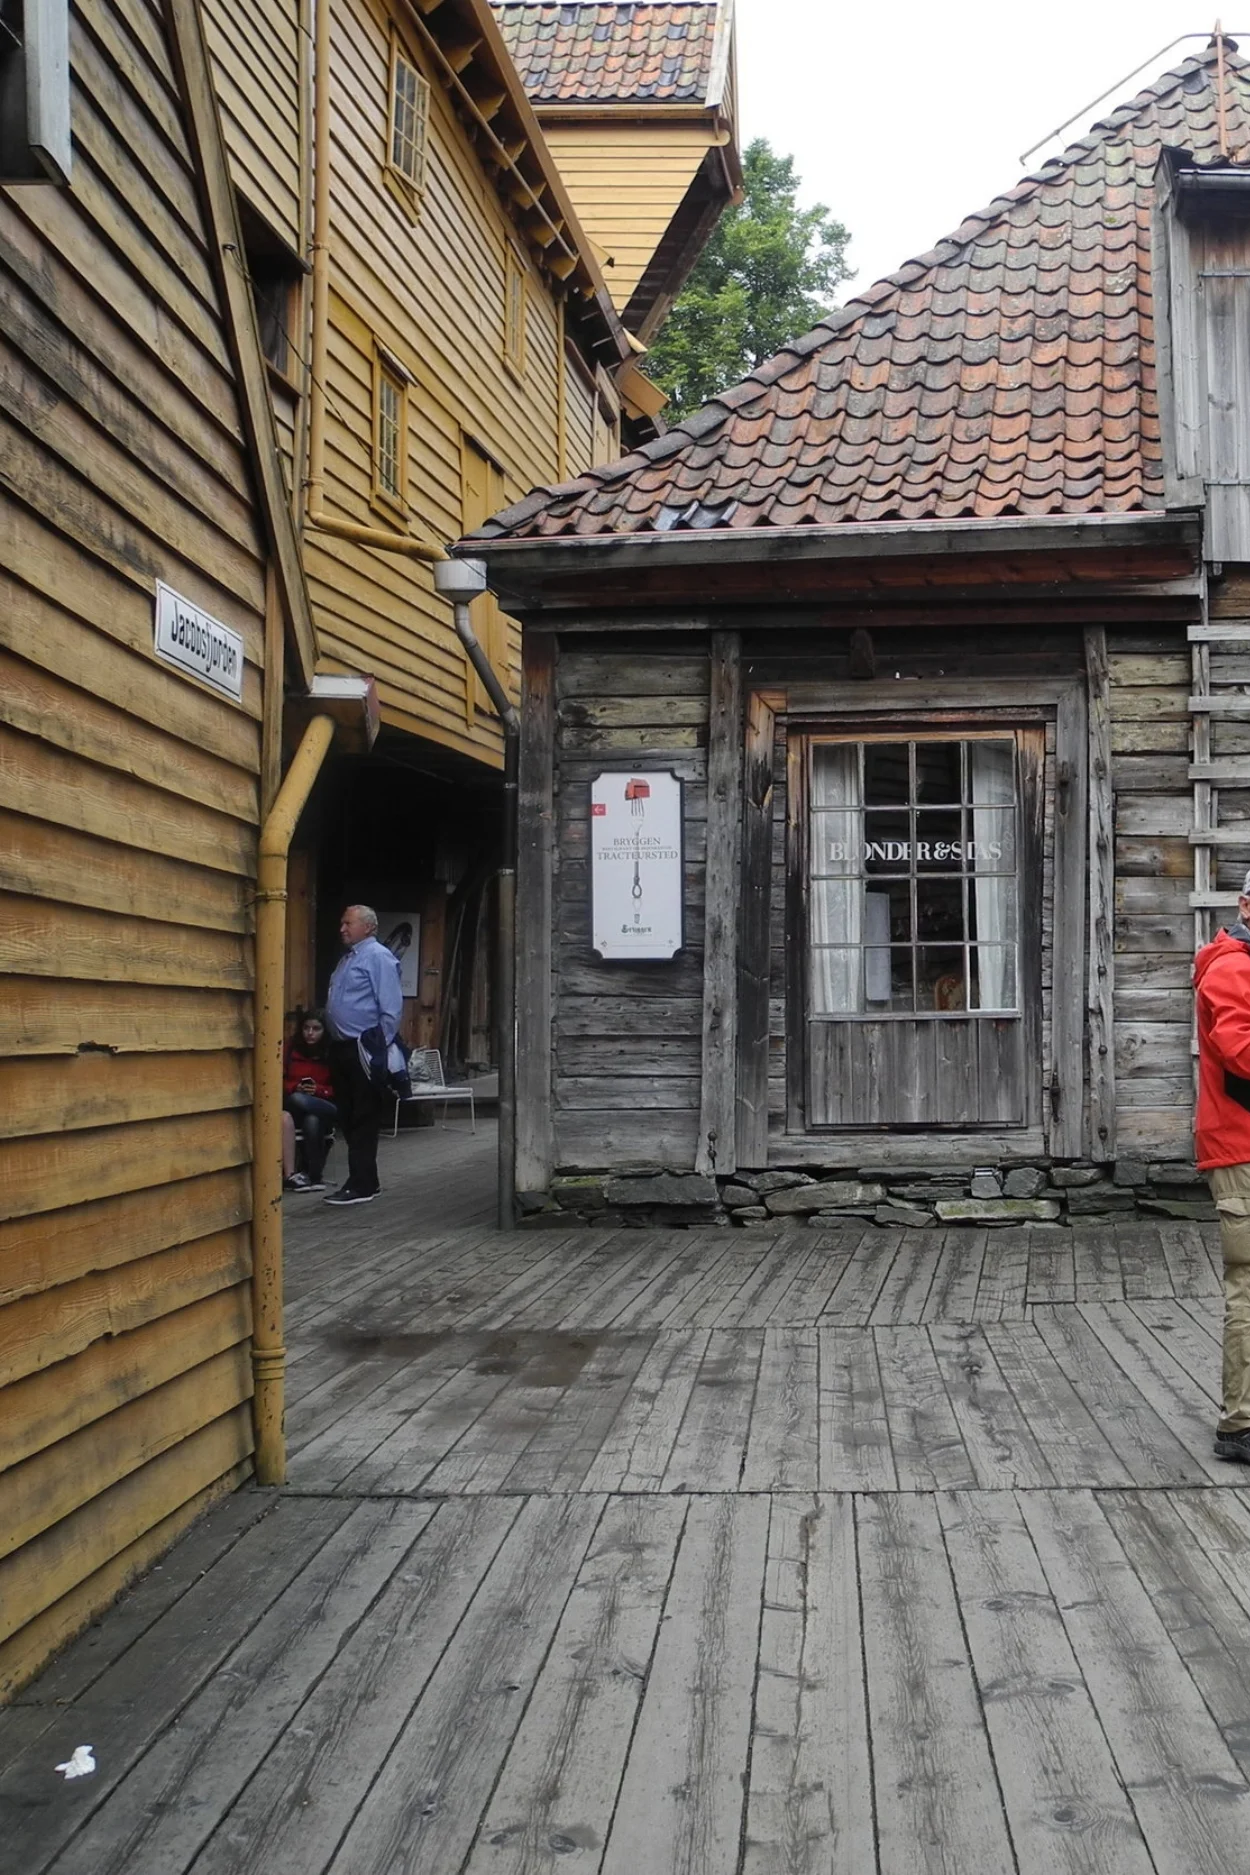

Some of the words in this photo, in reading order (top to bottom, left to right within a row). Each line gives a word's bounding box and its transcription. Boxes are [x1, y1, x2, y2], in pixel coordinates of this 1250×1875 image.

[171, 601, 237, 679] Jacobsfjorden
[613, 837, 661, 846] BRYGGEN
[597, 850, 679, 861] TRACTEURSTED
